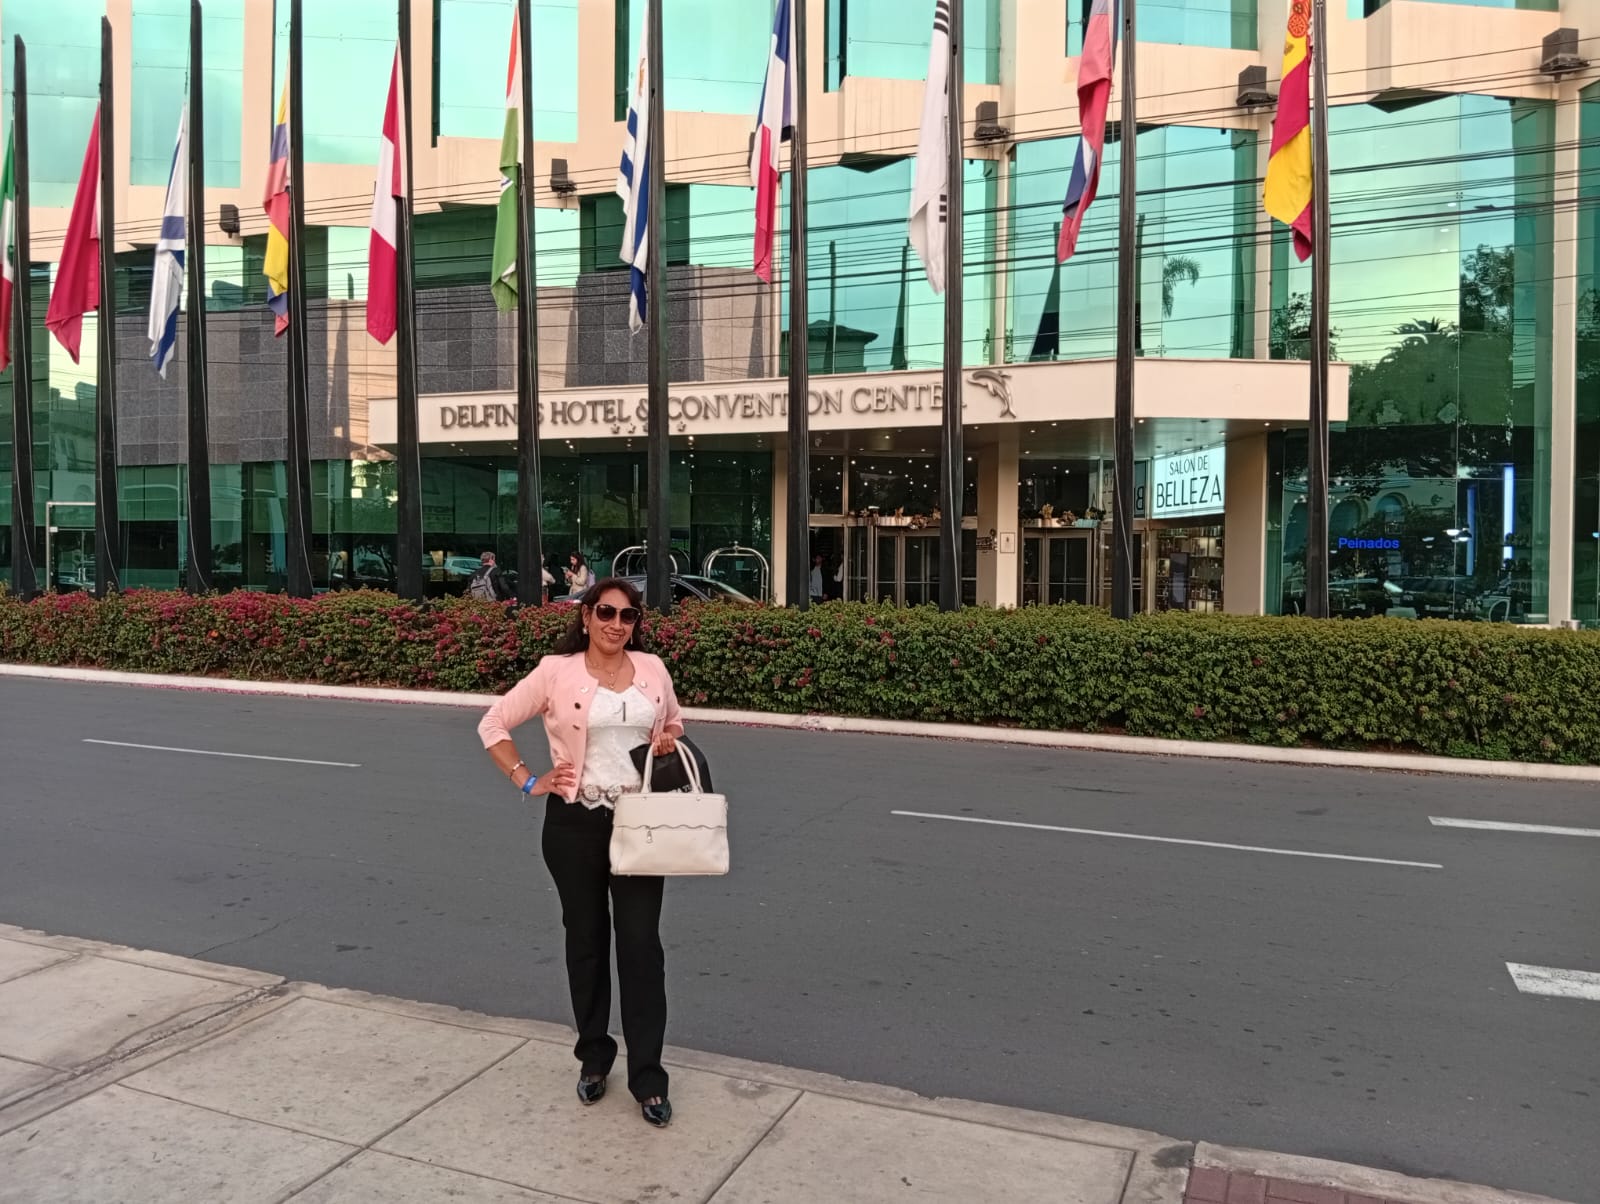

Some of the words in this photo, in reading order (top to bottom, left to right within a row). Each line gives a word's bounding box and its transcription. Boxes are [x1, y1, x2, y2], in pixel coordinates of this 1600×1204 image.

[440, 403, 545, 429] DELFINS
[550, 398, 631, 425] HOTEL
[667, 388, 843, 420] CONVENTON
[850, 382, 968, 413] CENTE
[1198, 455, 1208, 471] DE
[1156, 474, 1222, 508] BELLEZA
[1338, 537, 1400, 549] Peinados
